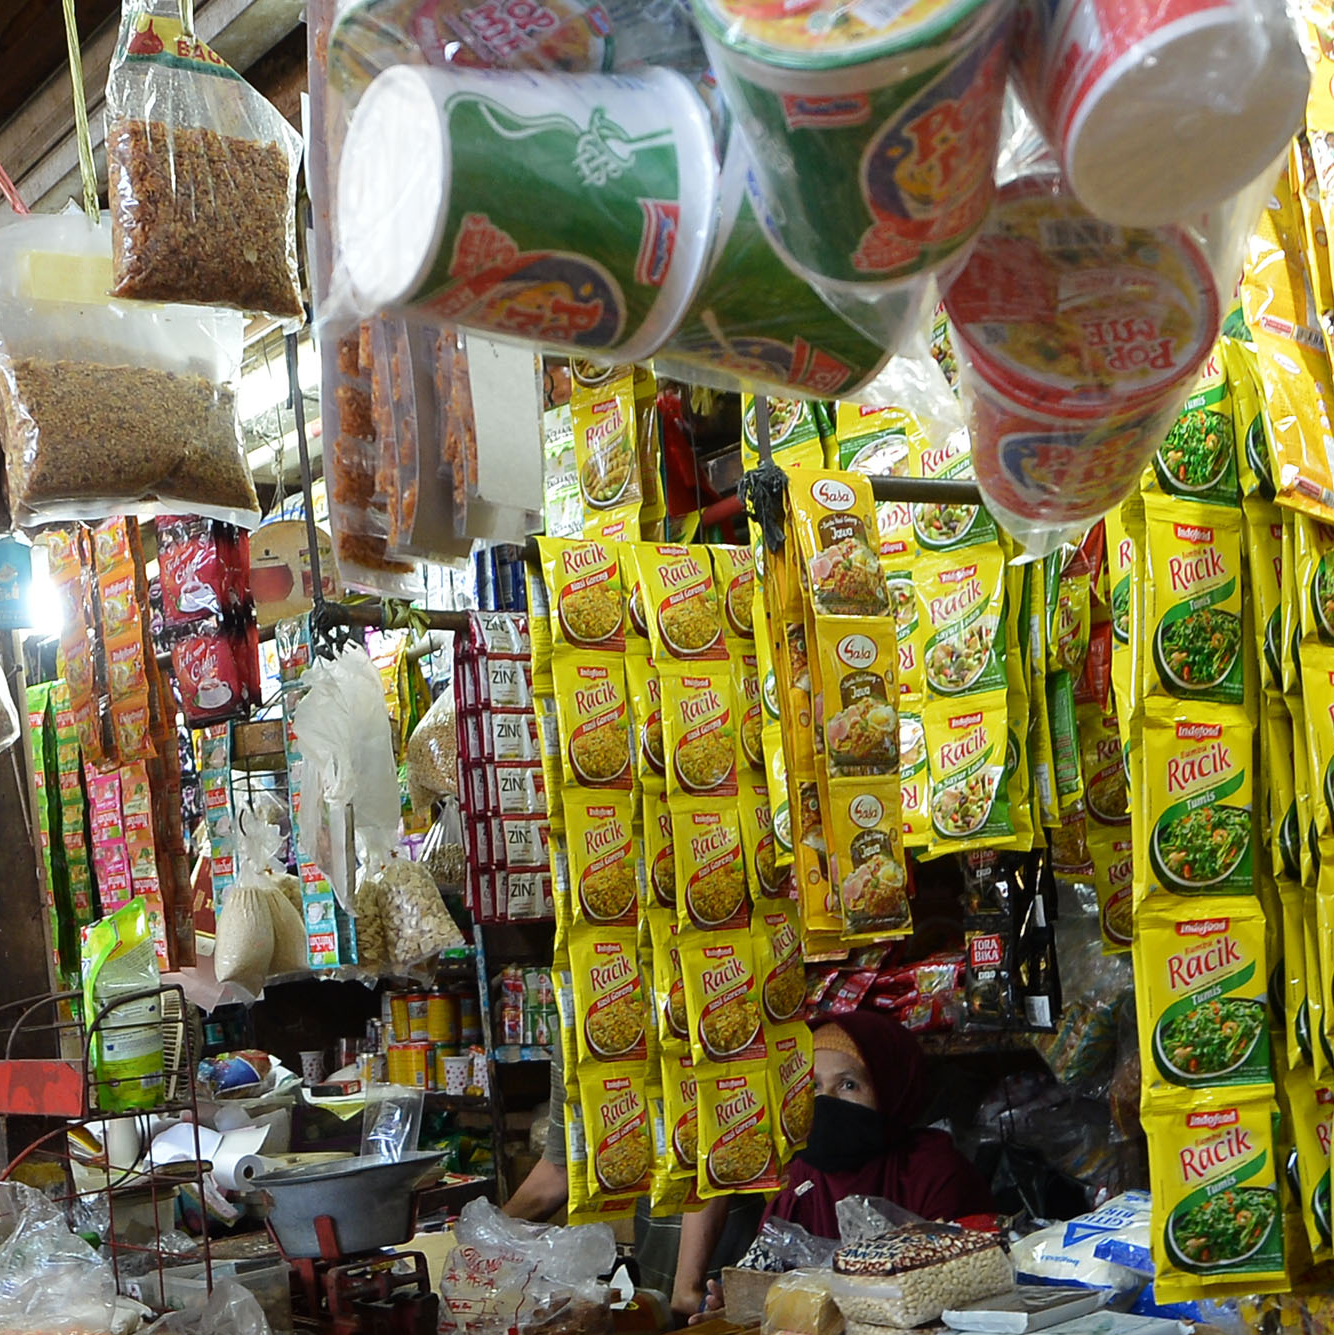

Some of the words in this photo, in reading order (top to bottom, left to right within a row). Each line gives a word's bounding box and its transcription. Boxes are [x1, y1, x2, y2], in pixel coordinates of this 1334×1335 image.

[1082, 319, 1158, 346] MIE
[1110, 338, 1177, 371] POP
[585, 411, 623, 449] Racik
[920, 436, 961, 476] Rac
[818, 481, 850, 505] Sasa
[879, 502, 914, 532] Rac
[830, 526, 854, 540] Jawa
[1176, 526, 1212, 543] Indofood
[561, 543, 608, 574] Racik
[658, 558, 703, 588] Racik
[1169, 547, 1226, 591] Racik
[930, 579, 982, 625] Racik
[935, 625, 959, 642] Sayur
[843, 639, 871, 660] Sasa
[574, 681, 617, 714] Racik
[679, 690, 721, 724] Racik
[950, 713, 981, 728] Indofood
[1178, 726, 1220, 739] Indofood
[939, 727, 988, 769] Racik
[1167, 742, 1232, 793] Racik
[854, 800, 878, 819] Sasa
[1186, 791, 1216, 811] Tumis
[584, 820, 625, 854] Racik
[690, 826, 733, 862] Racik
[1179, 921, 1227, 935] Indofood
[972, 939, 998, 950] TORA
[974, 950, 999, 962] BIKA
[590, 956, 633, 992] Racik
[701, 958, 746, 994] Racik
[1167, 936, 1241, 990] Racik
[1192, 985, 1223, 1005] Tumis
[779, 1049, 807, 1085] Racik
[600, 1091, 639, 1128] Racik
[714, 1090, 758, 1127] Racik
[1189, 1112, 1237, 1126] Indofood
[1178, 1127, 1252, 1181] Racik
[1205, 1176, 1237, 1196] Tumis
